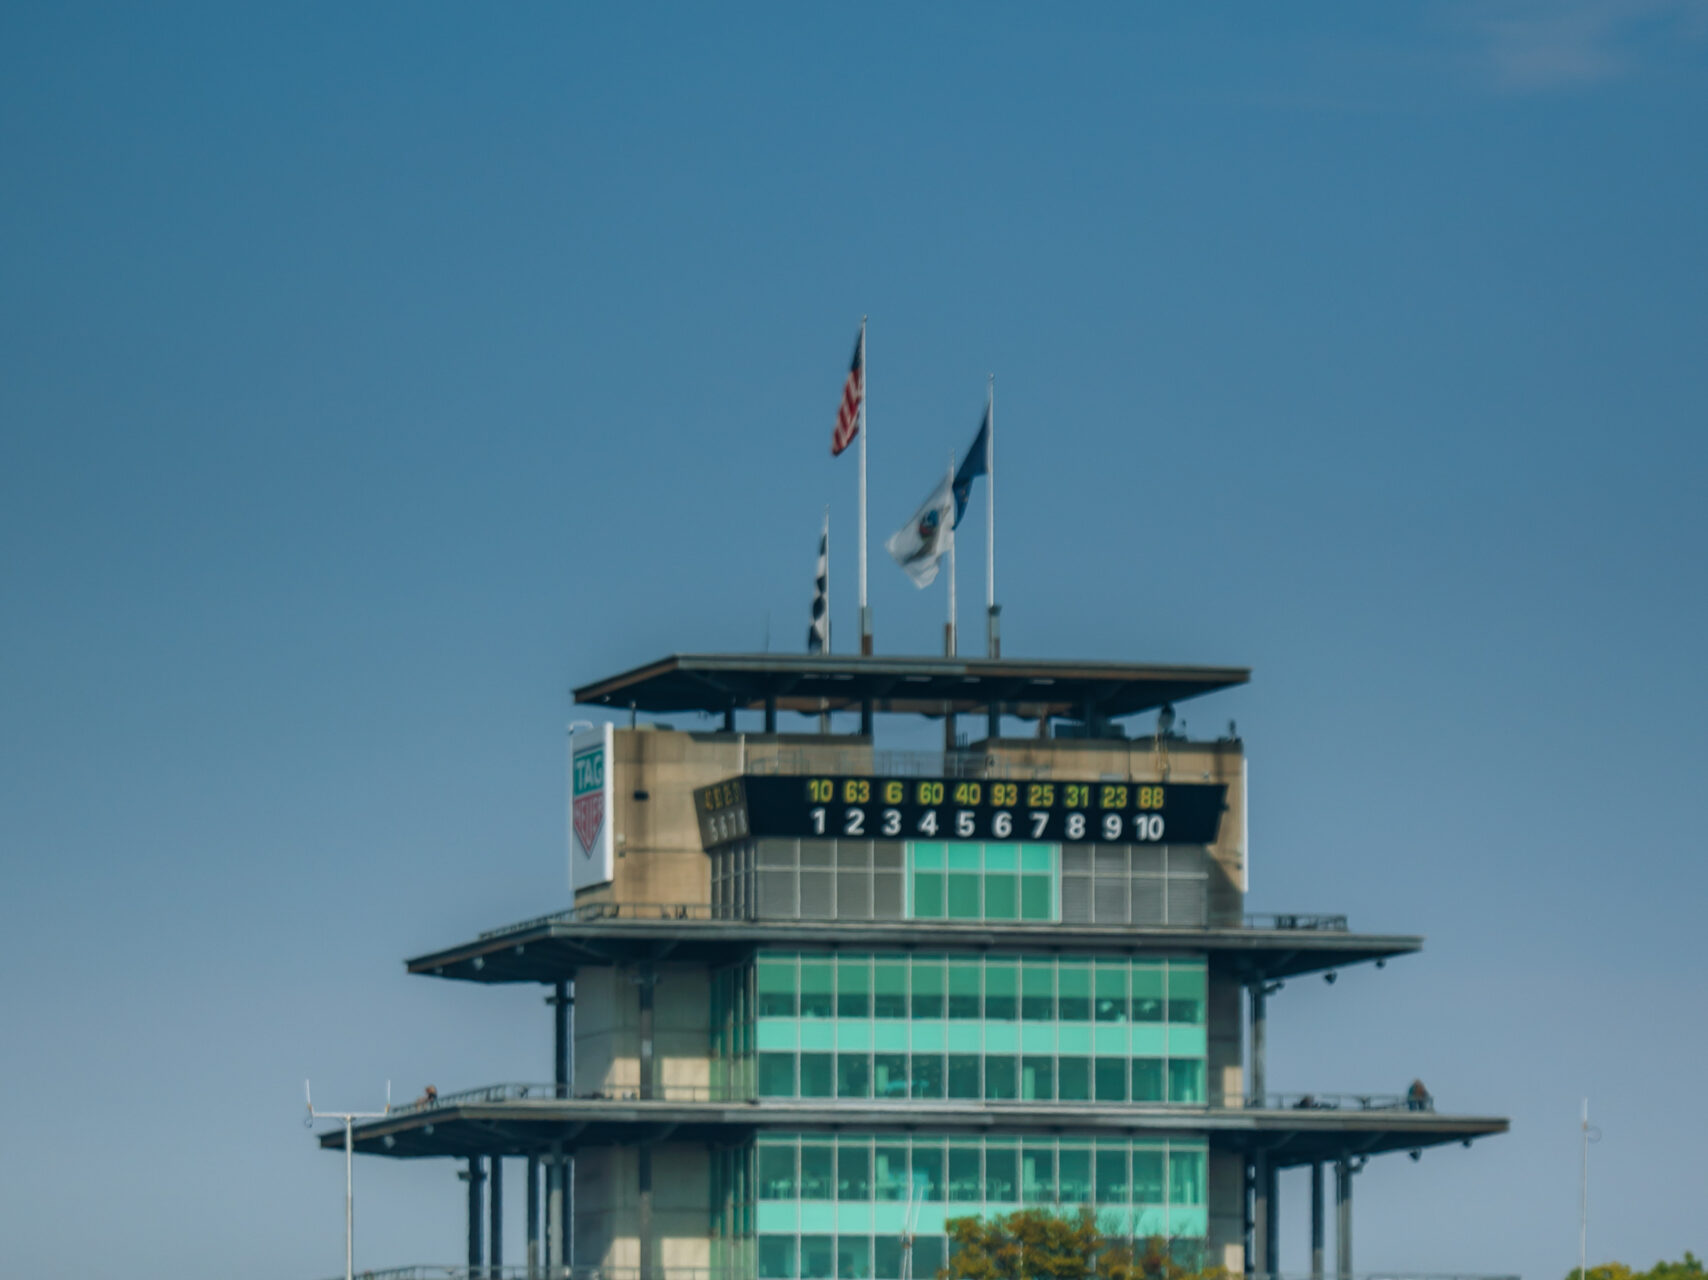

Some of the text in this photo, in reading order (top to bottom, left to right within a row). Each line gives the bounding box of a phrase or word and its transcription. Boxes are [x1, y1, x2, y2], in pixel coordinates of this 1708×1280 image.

[574, 757, 603, 792] TAG
[810, 780, 1164, 810] 10 63 6 60 40 93 25 31 23 88
[813, 807, 1165, 842] 1 2 3 4 5 6 7 8 9 10
